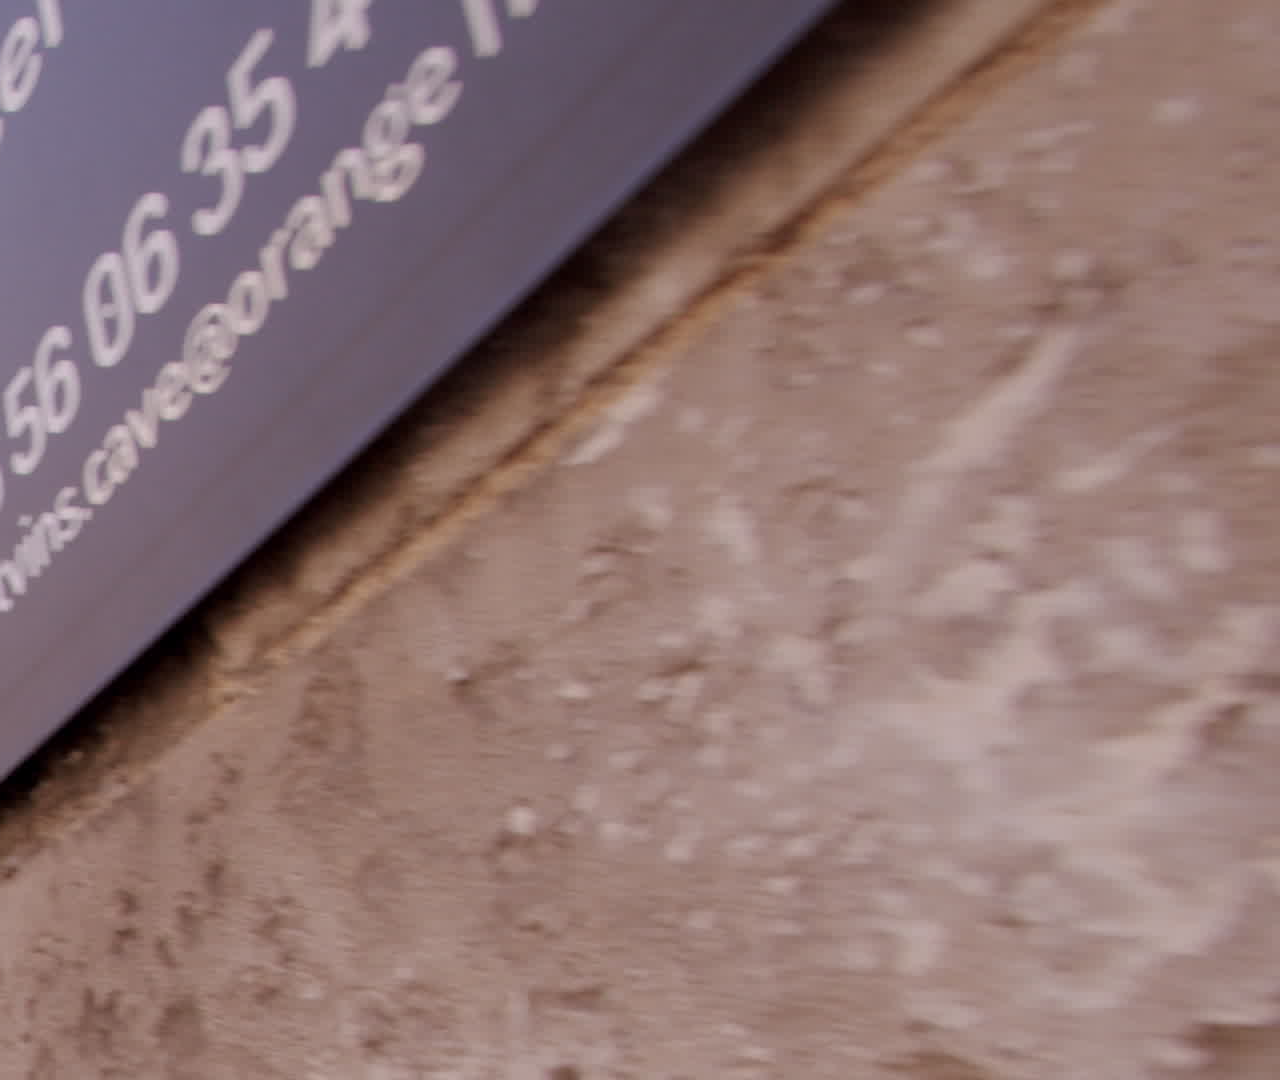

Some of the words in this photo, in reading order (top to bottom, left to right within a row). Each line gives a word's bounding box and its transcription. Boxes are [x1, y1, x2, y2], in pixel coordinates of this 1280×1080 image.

[2, 325, 81, 476] 56
[82, 192, 180, 367] 06
[181, 28, 296, 236] 35
